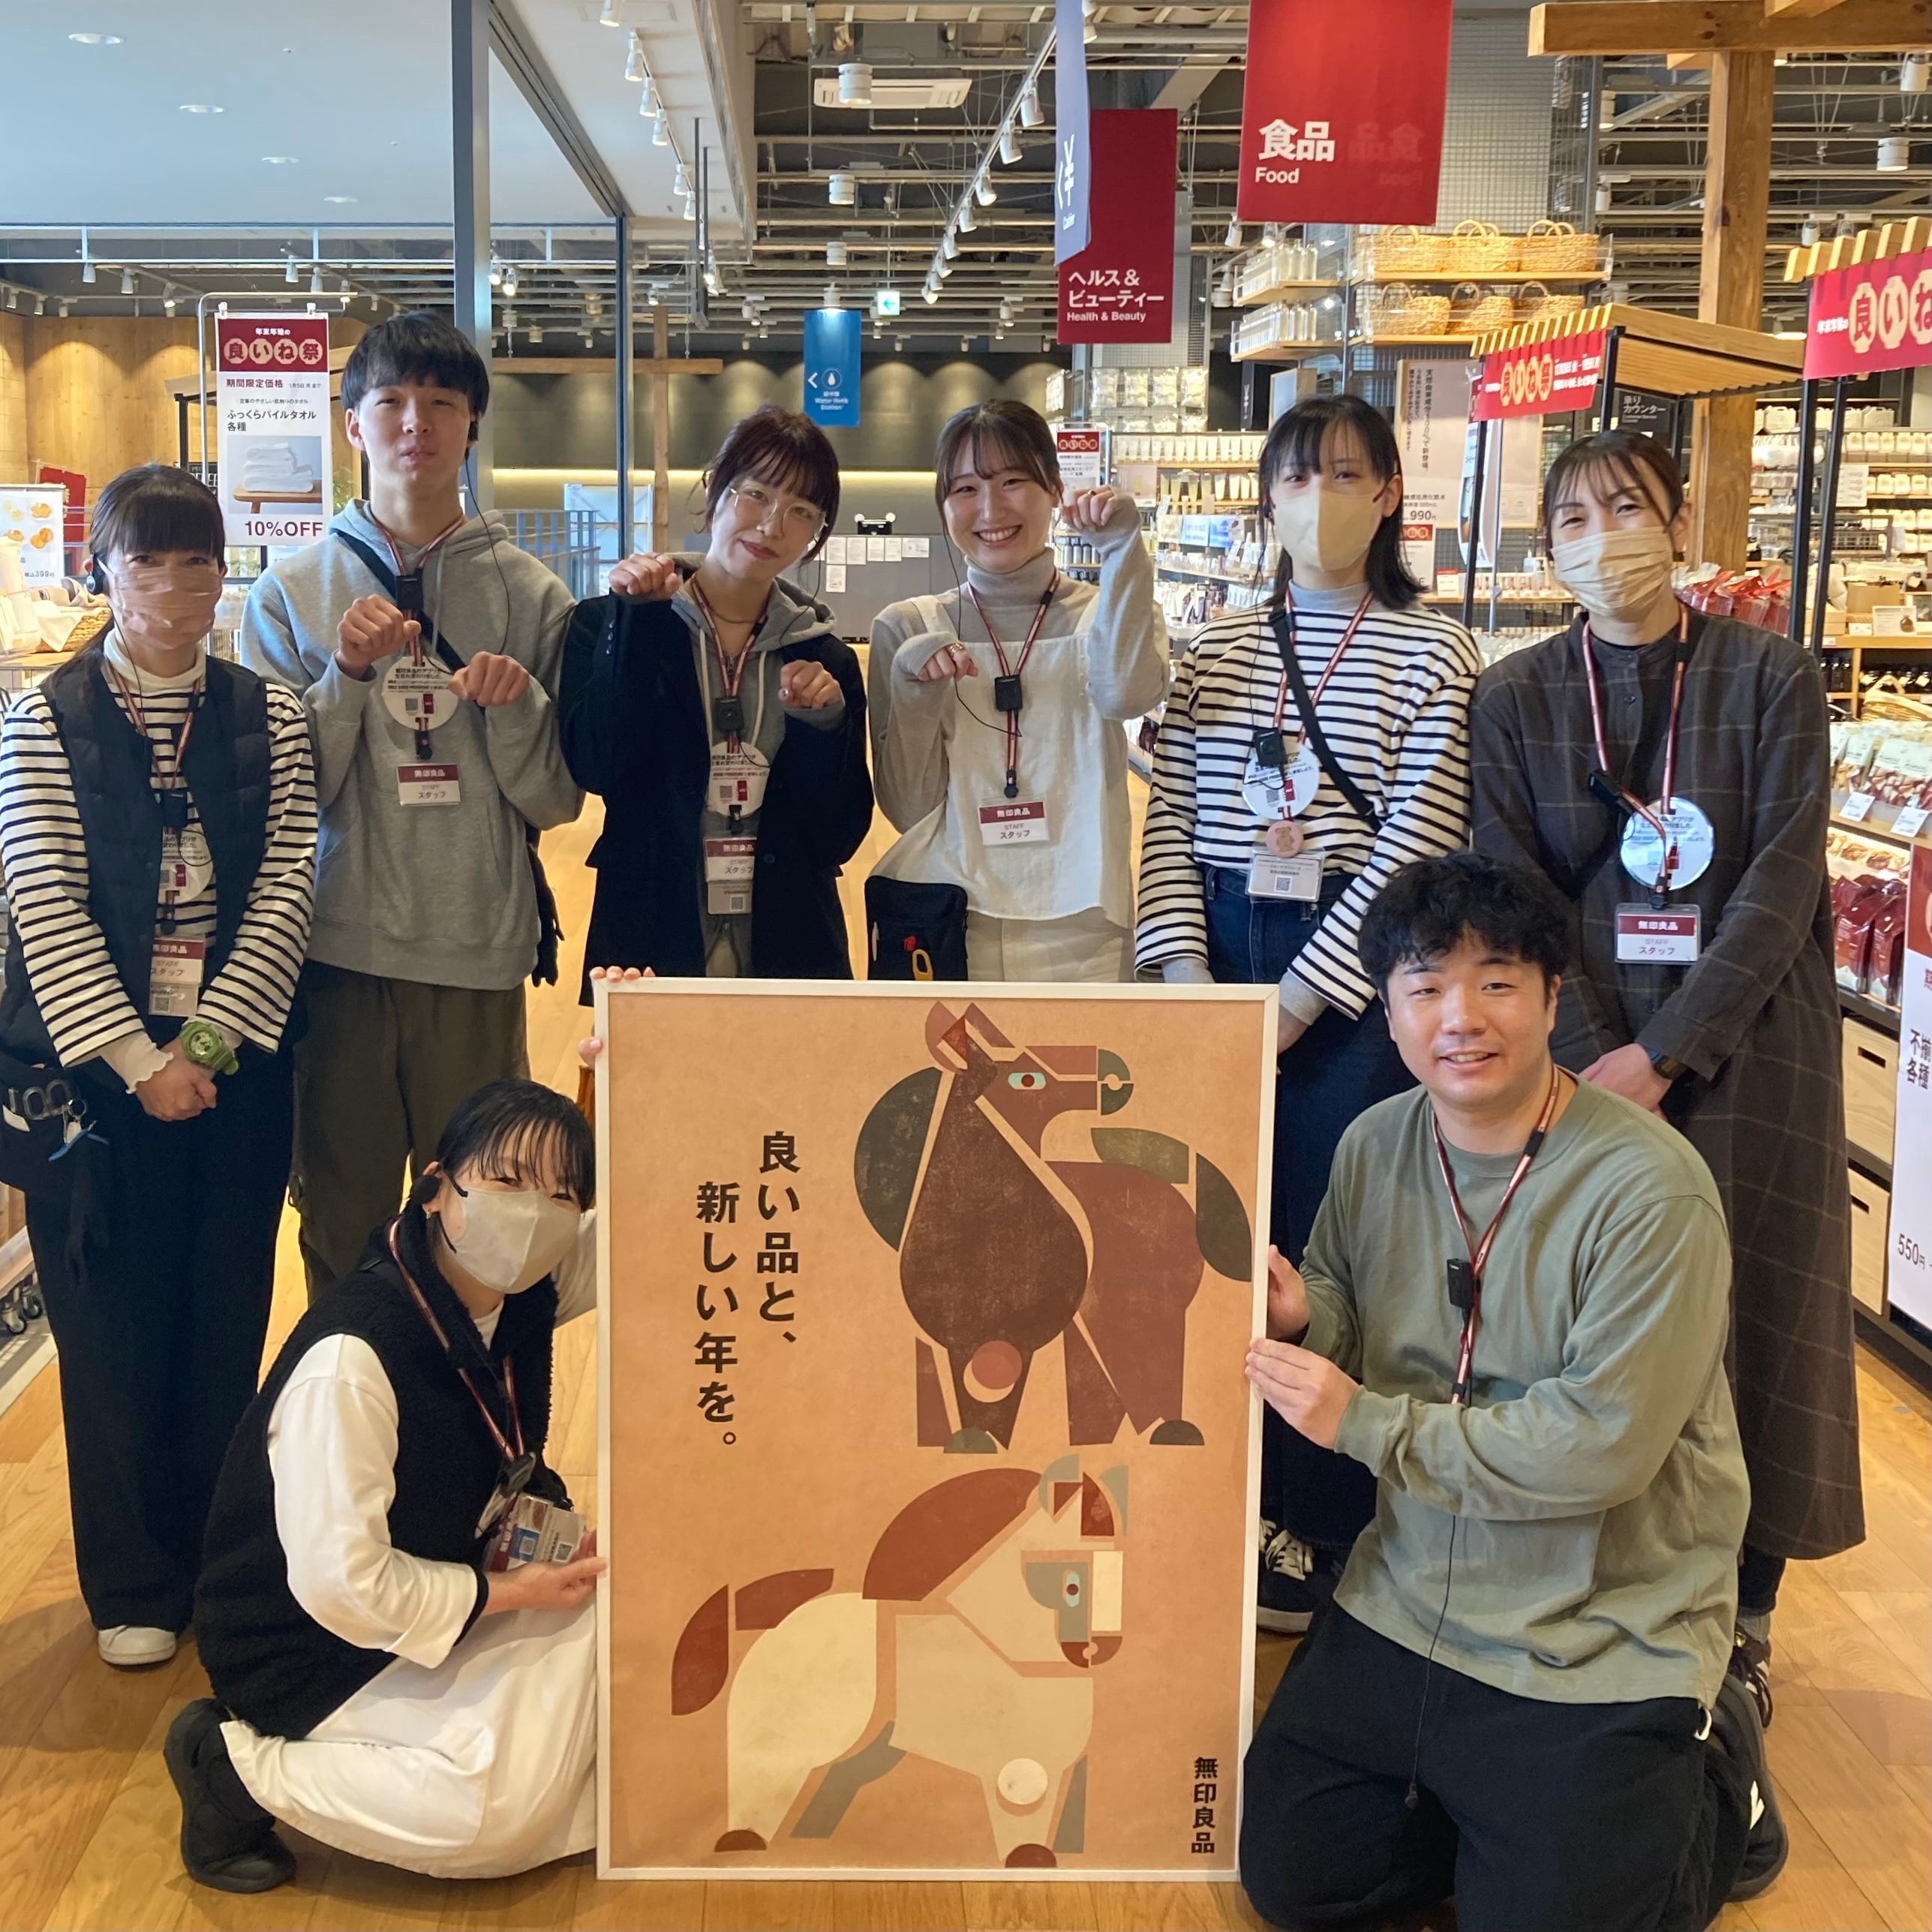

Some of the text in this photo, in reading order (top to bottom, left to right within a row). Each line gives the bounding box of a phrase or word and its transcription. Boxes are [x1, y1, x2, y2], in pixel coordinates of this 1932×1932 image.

[1258, 119, 1335, 161] 食品
[1255, 167, 1300, 184] Food
[1069, 290, 1164, 308] ビューティー
[1067, 311, 1146, 323] Health & Beauty
[227, 342, 320, 360] 良いね祭
[226, 379, 283, 388] 期間限定価格
[227, 410, 317, 420] ふっくらパイルタオル
[1624, 405, 1666, 413] カウンター
[227, 422, 246, 432] 各種
[245, 521, 323, 536] 10%OFF
[1000, 830, 1030, 840] スタッフ
[725, 867, 753, 875] スタッフ
[1639, 947, 1675, 956] スタッフ
[150, 968, 184, 977] スタッフ
[1906, 1058, 1930, 1090] 各種
[757, 1131, 801, 1343] 良い品と、
[694, 1181, 740, 1445] 新しい年を。
[1191, 1756, 1219, 1854] 無印良品
